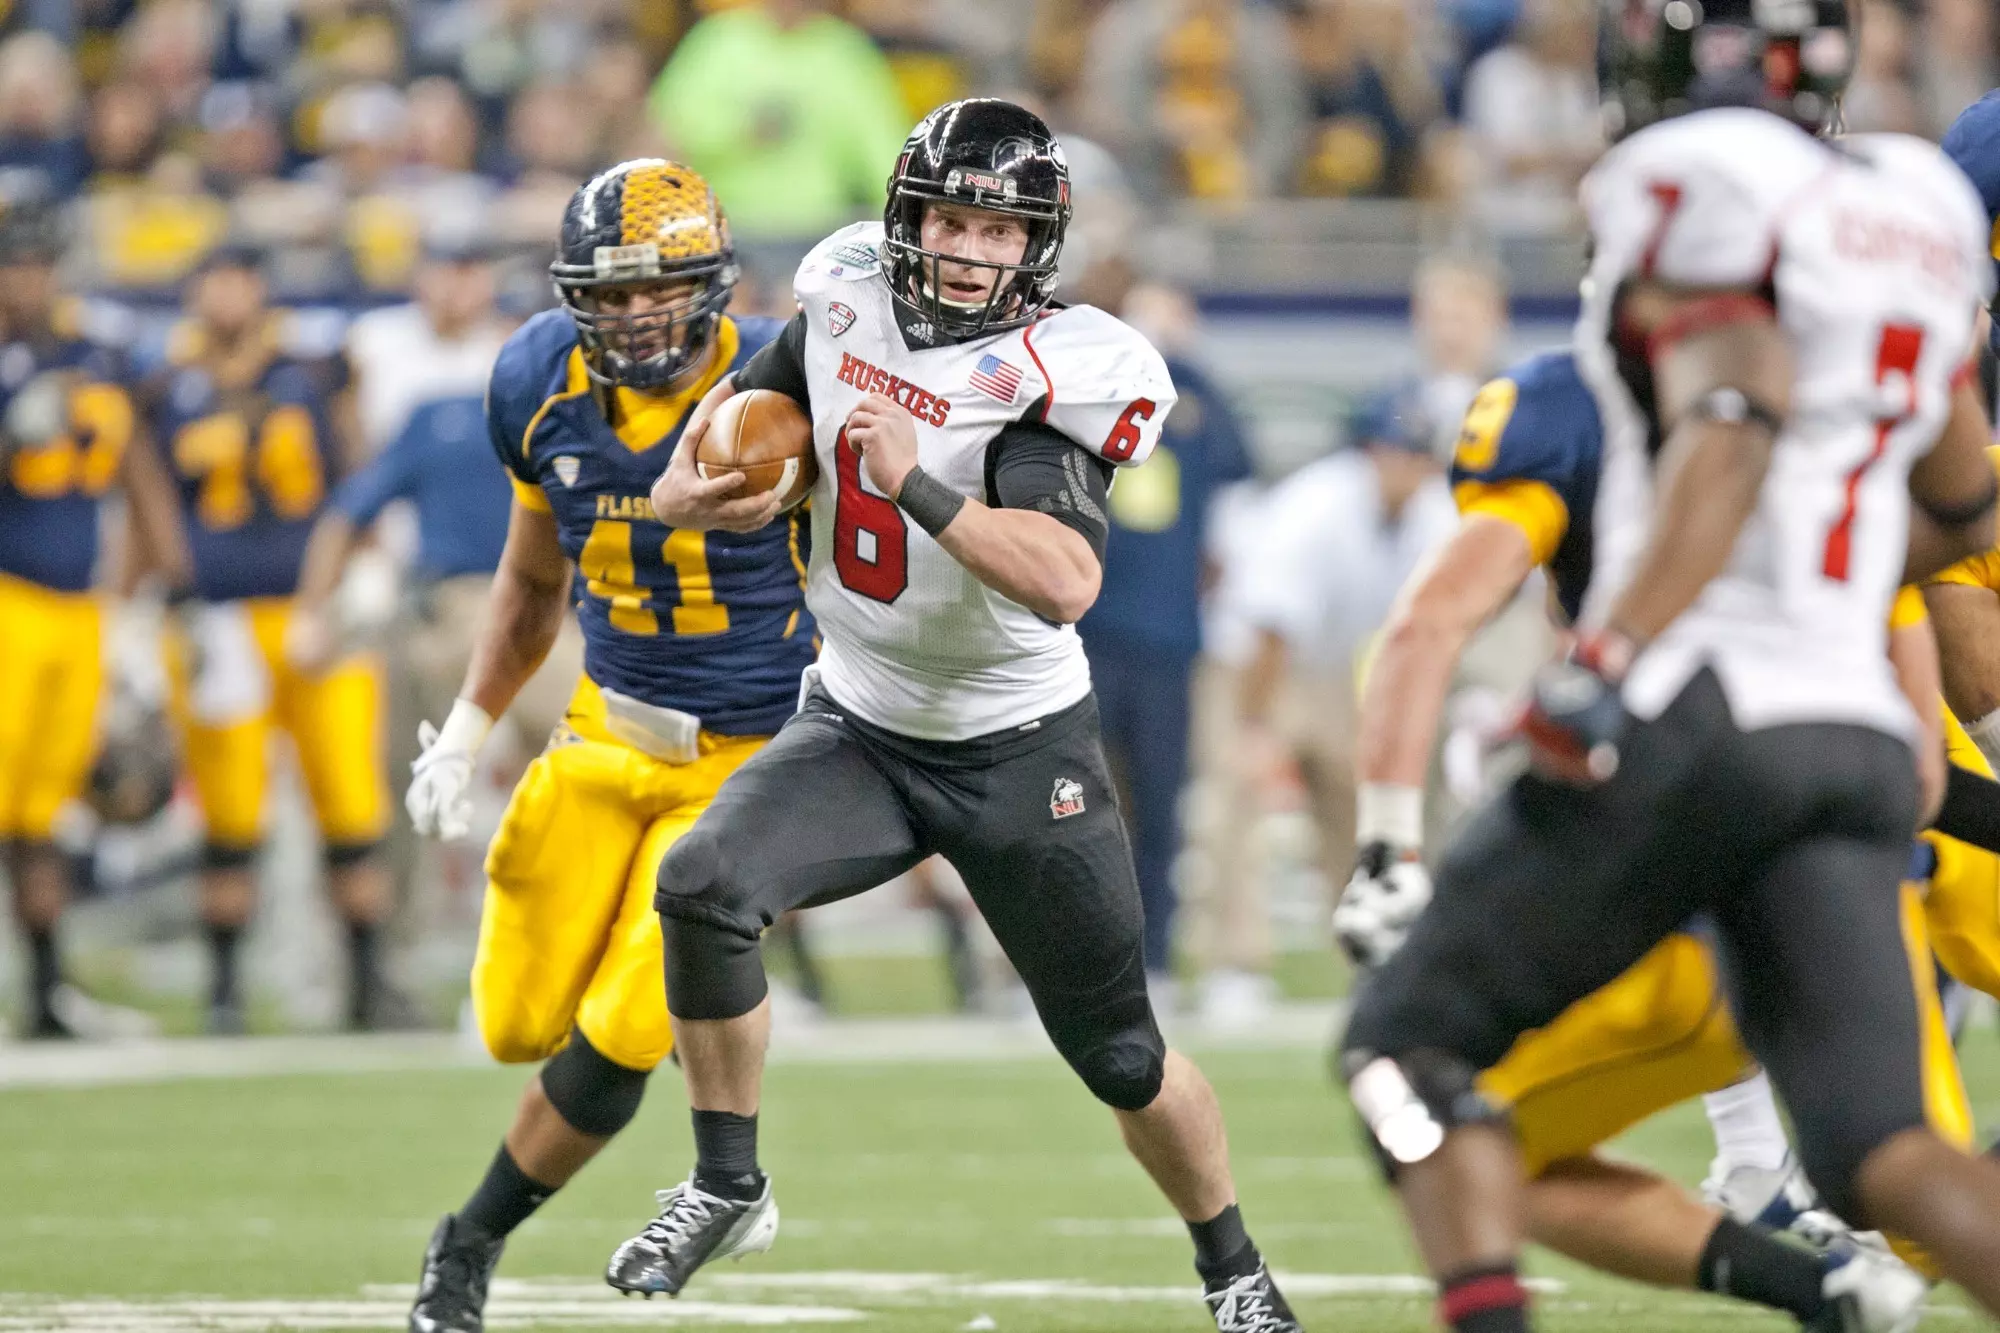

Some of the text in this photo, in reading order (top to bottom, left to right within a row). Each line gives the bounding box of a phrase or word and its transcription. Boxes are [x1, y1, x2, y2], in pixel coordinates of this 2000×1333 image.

[964, 172, 1001, 190] NIU
[1643, 179, 1685, 279] 7
[905, 324, 935, 346] adidas
[836, 351, 951, 428] HUSKIES
[1101, 396, 1157, 462] 6
[1821, 322, 1926, 581] 7
[834, 423, 908, 604] 6
[579, 519, 730, 636] 41
